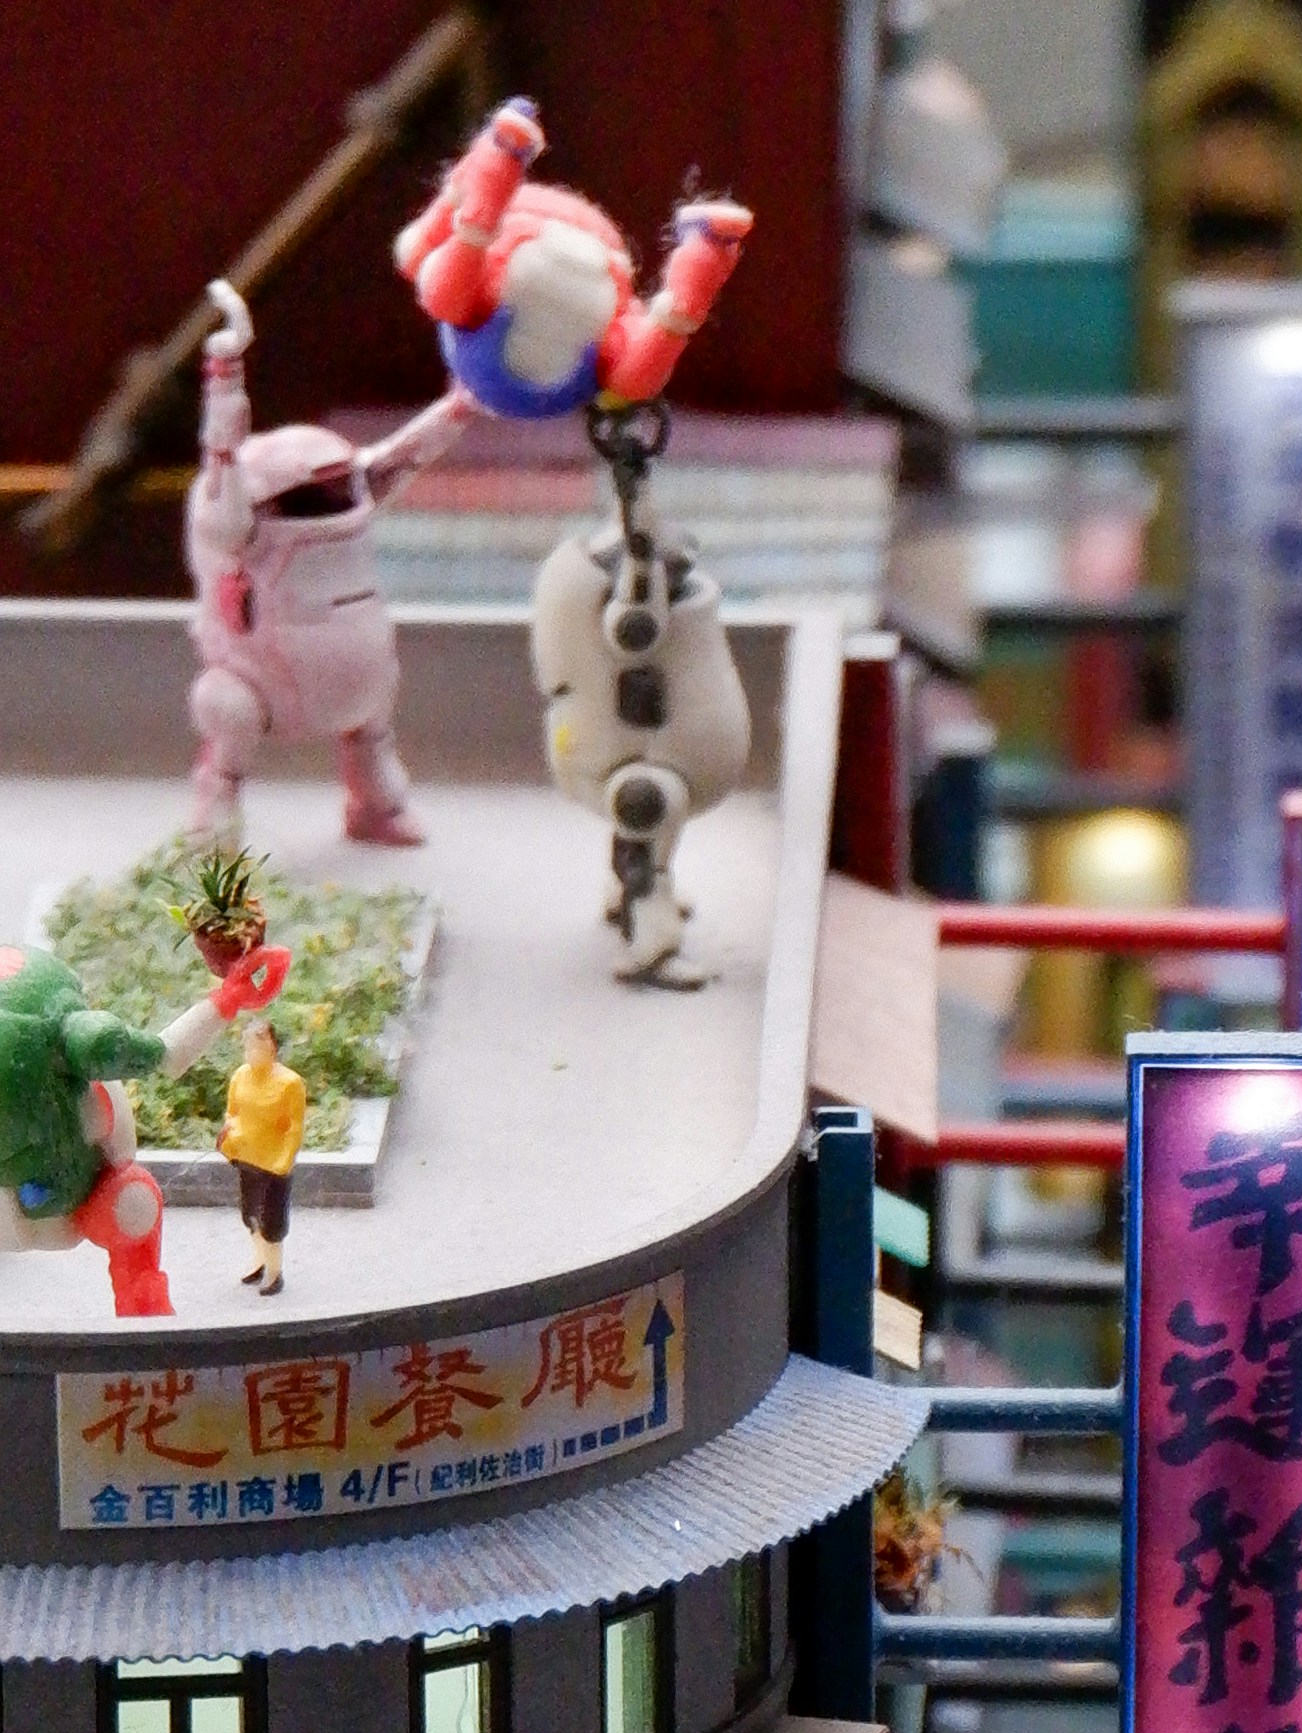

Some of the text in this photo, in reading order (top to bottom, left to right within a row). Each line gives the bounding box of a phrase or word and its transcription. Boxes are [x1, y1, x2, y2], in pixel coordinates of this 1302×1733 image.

[82, 1300, 637, 1467] 花園餐廳
[89, 1469, 325, 1524] 金百利商場
